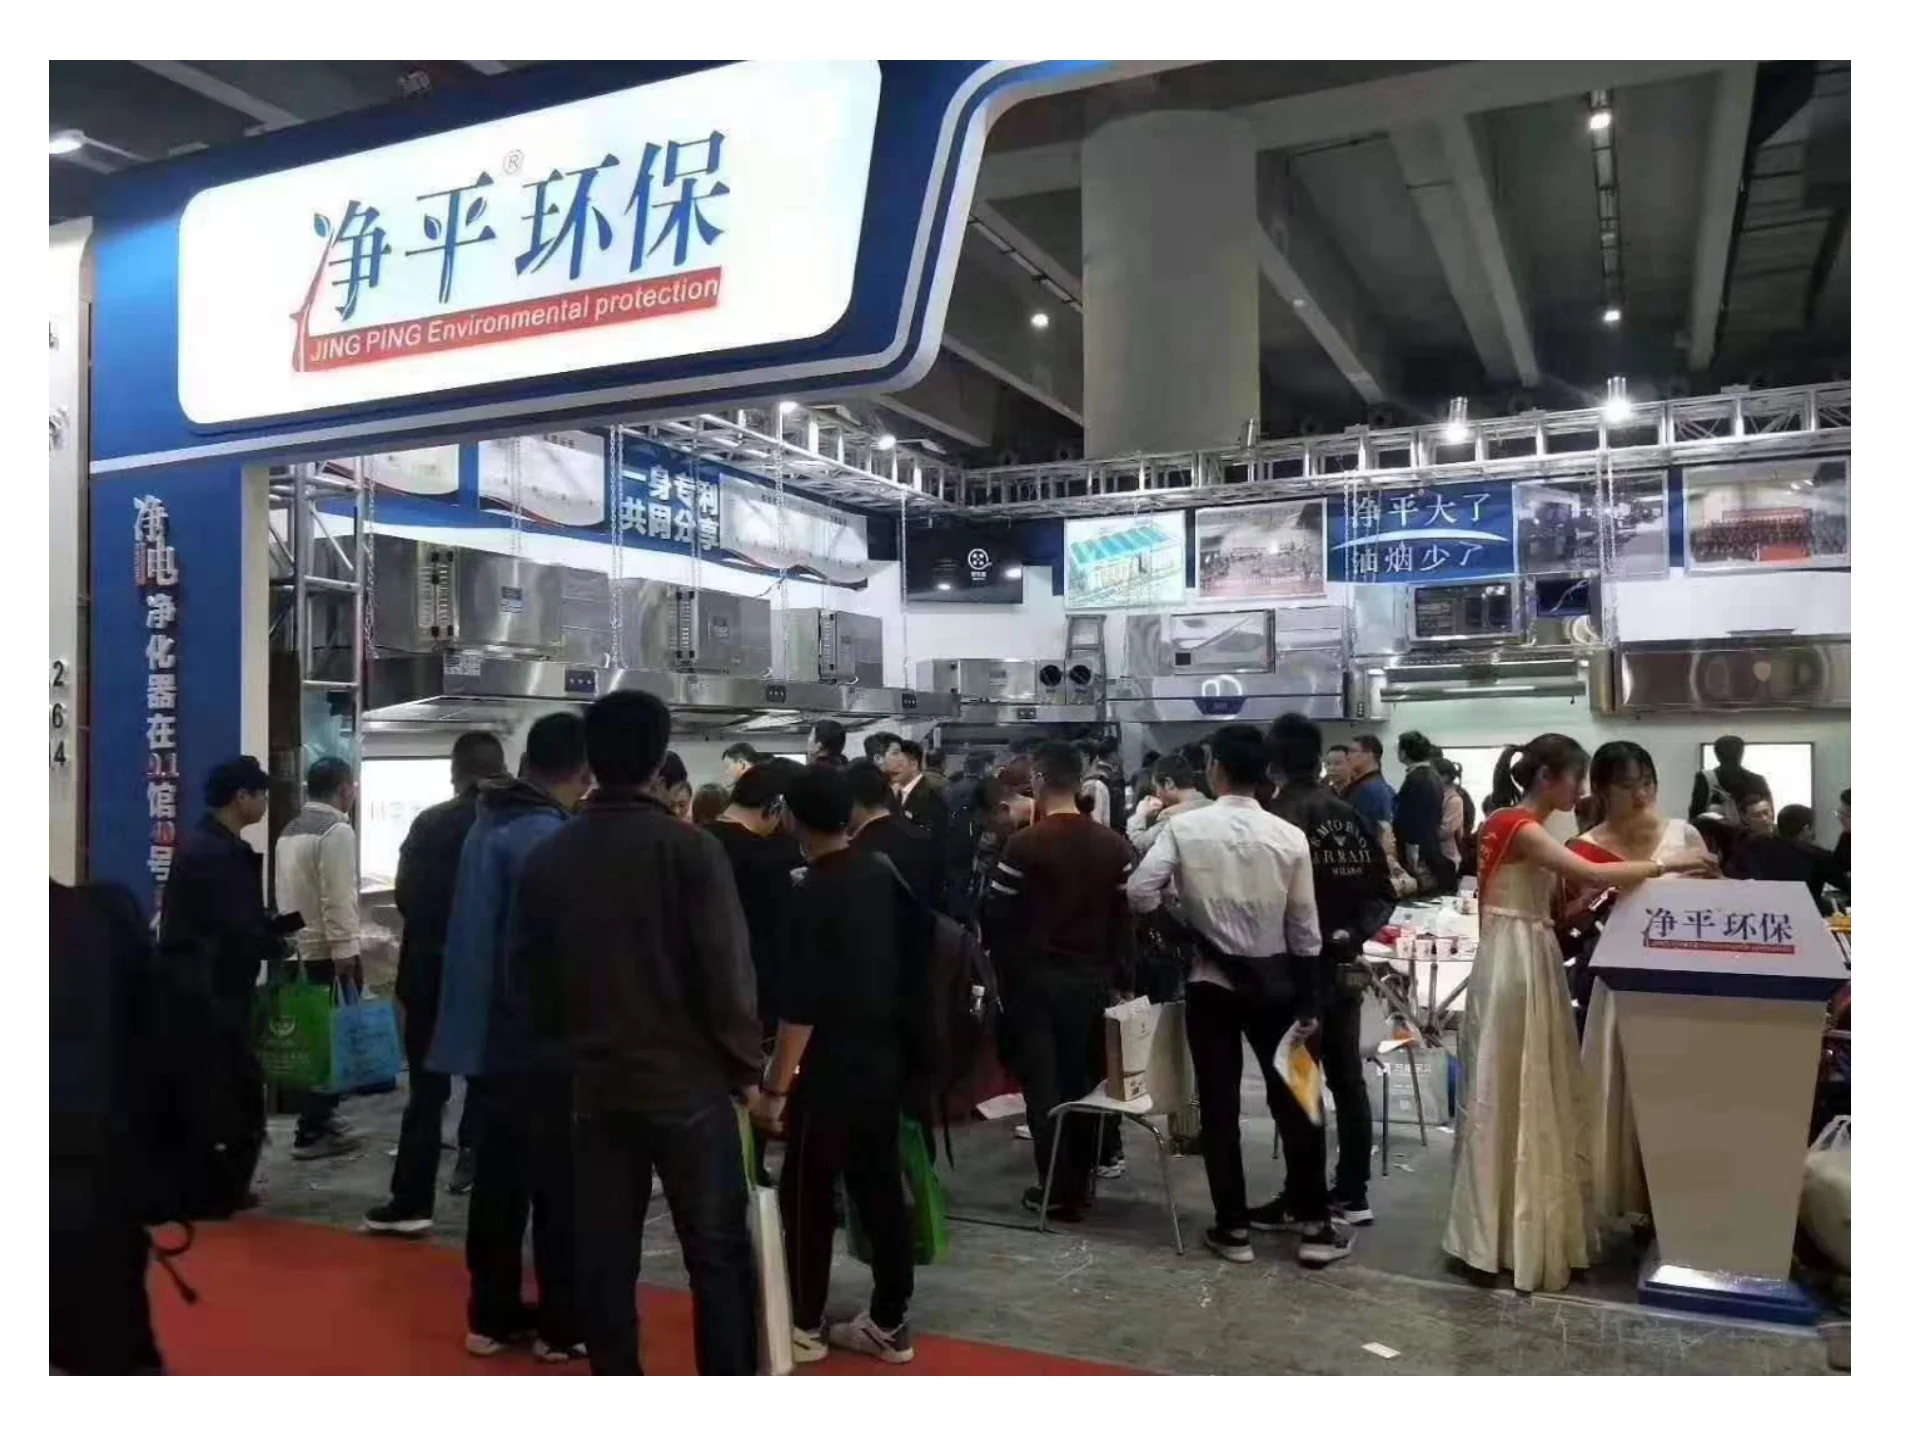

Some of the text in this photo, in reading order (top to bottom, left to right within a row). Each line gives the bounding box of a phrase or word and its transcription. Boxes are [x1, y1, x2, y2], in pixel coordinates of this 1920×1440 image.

[311, 130, 730, 322] 净平环保
[311, 275, 719, 362] JING PING Environmental protection
[621, 464, 719, 516] 一身专利
[1351, 493, 1490, 529] 净平大了
[619, 497, 720, 550] 共同分享
[1351, 540, 1484, 574] 油烟少了
[1642, 908, 1793, 943] 净平环保
